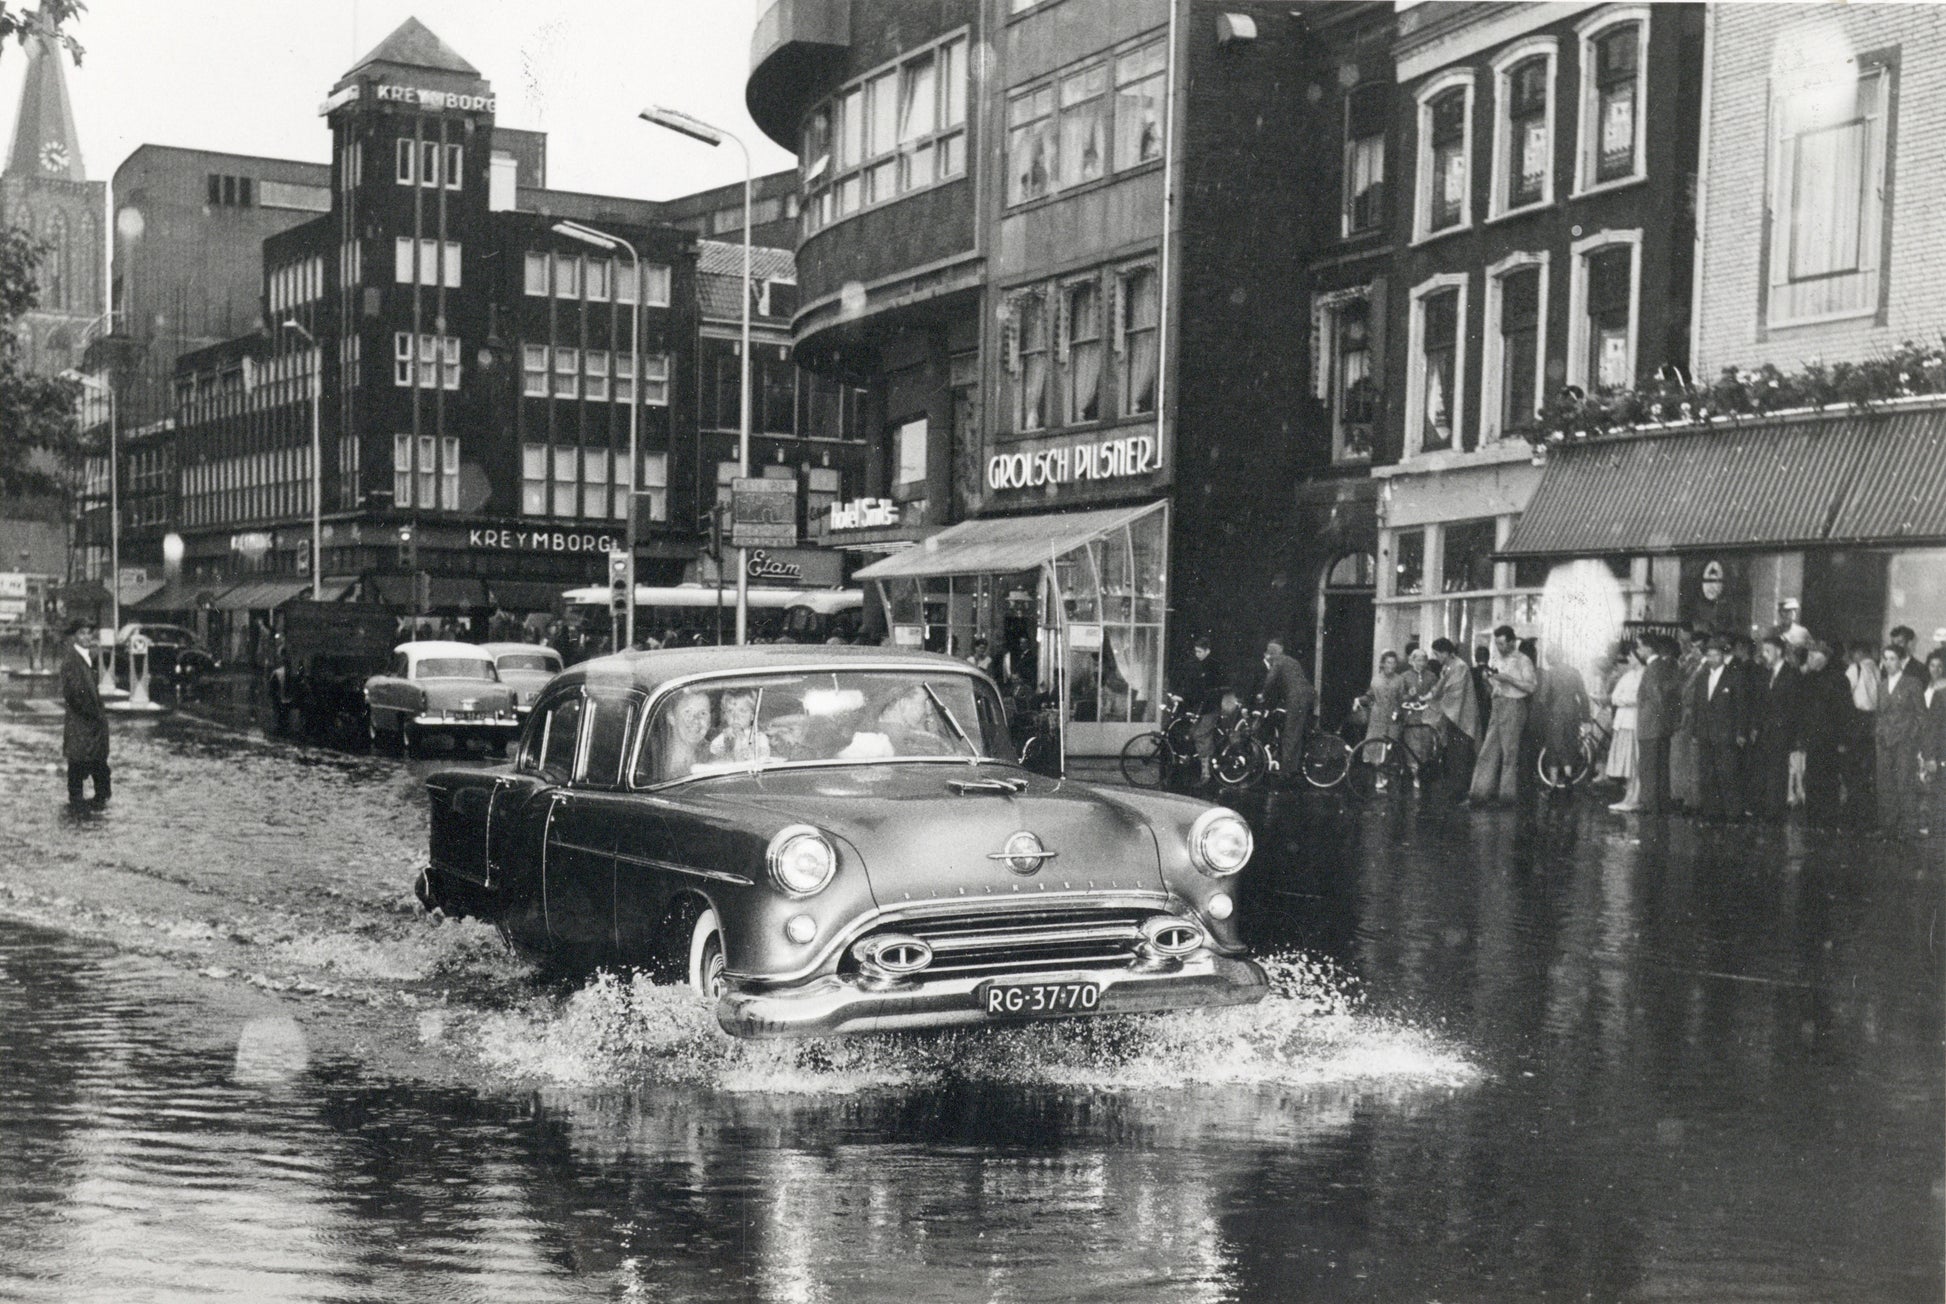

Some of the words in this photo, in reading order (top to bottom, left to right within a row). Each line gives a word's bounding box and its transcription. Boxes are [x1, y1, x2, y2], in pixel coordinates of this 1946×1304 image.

[988, 447, 1068, 489] GROLSCH
[1074, 436, 1152, 480] PILSNER
[831, 499, 859, 530] hotel
[470, 529, 611, 552] KREYMBORG
[747, 549, 801, 577] Etam
[989, 985, 1097, 1012] RG-37-70
